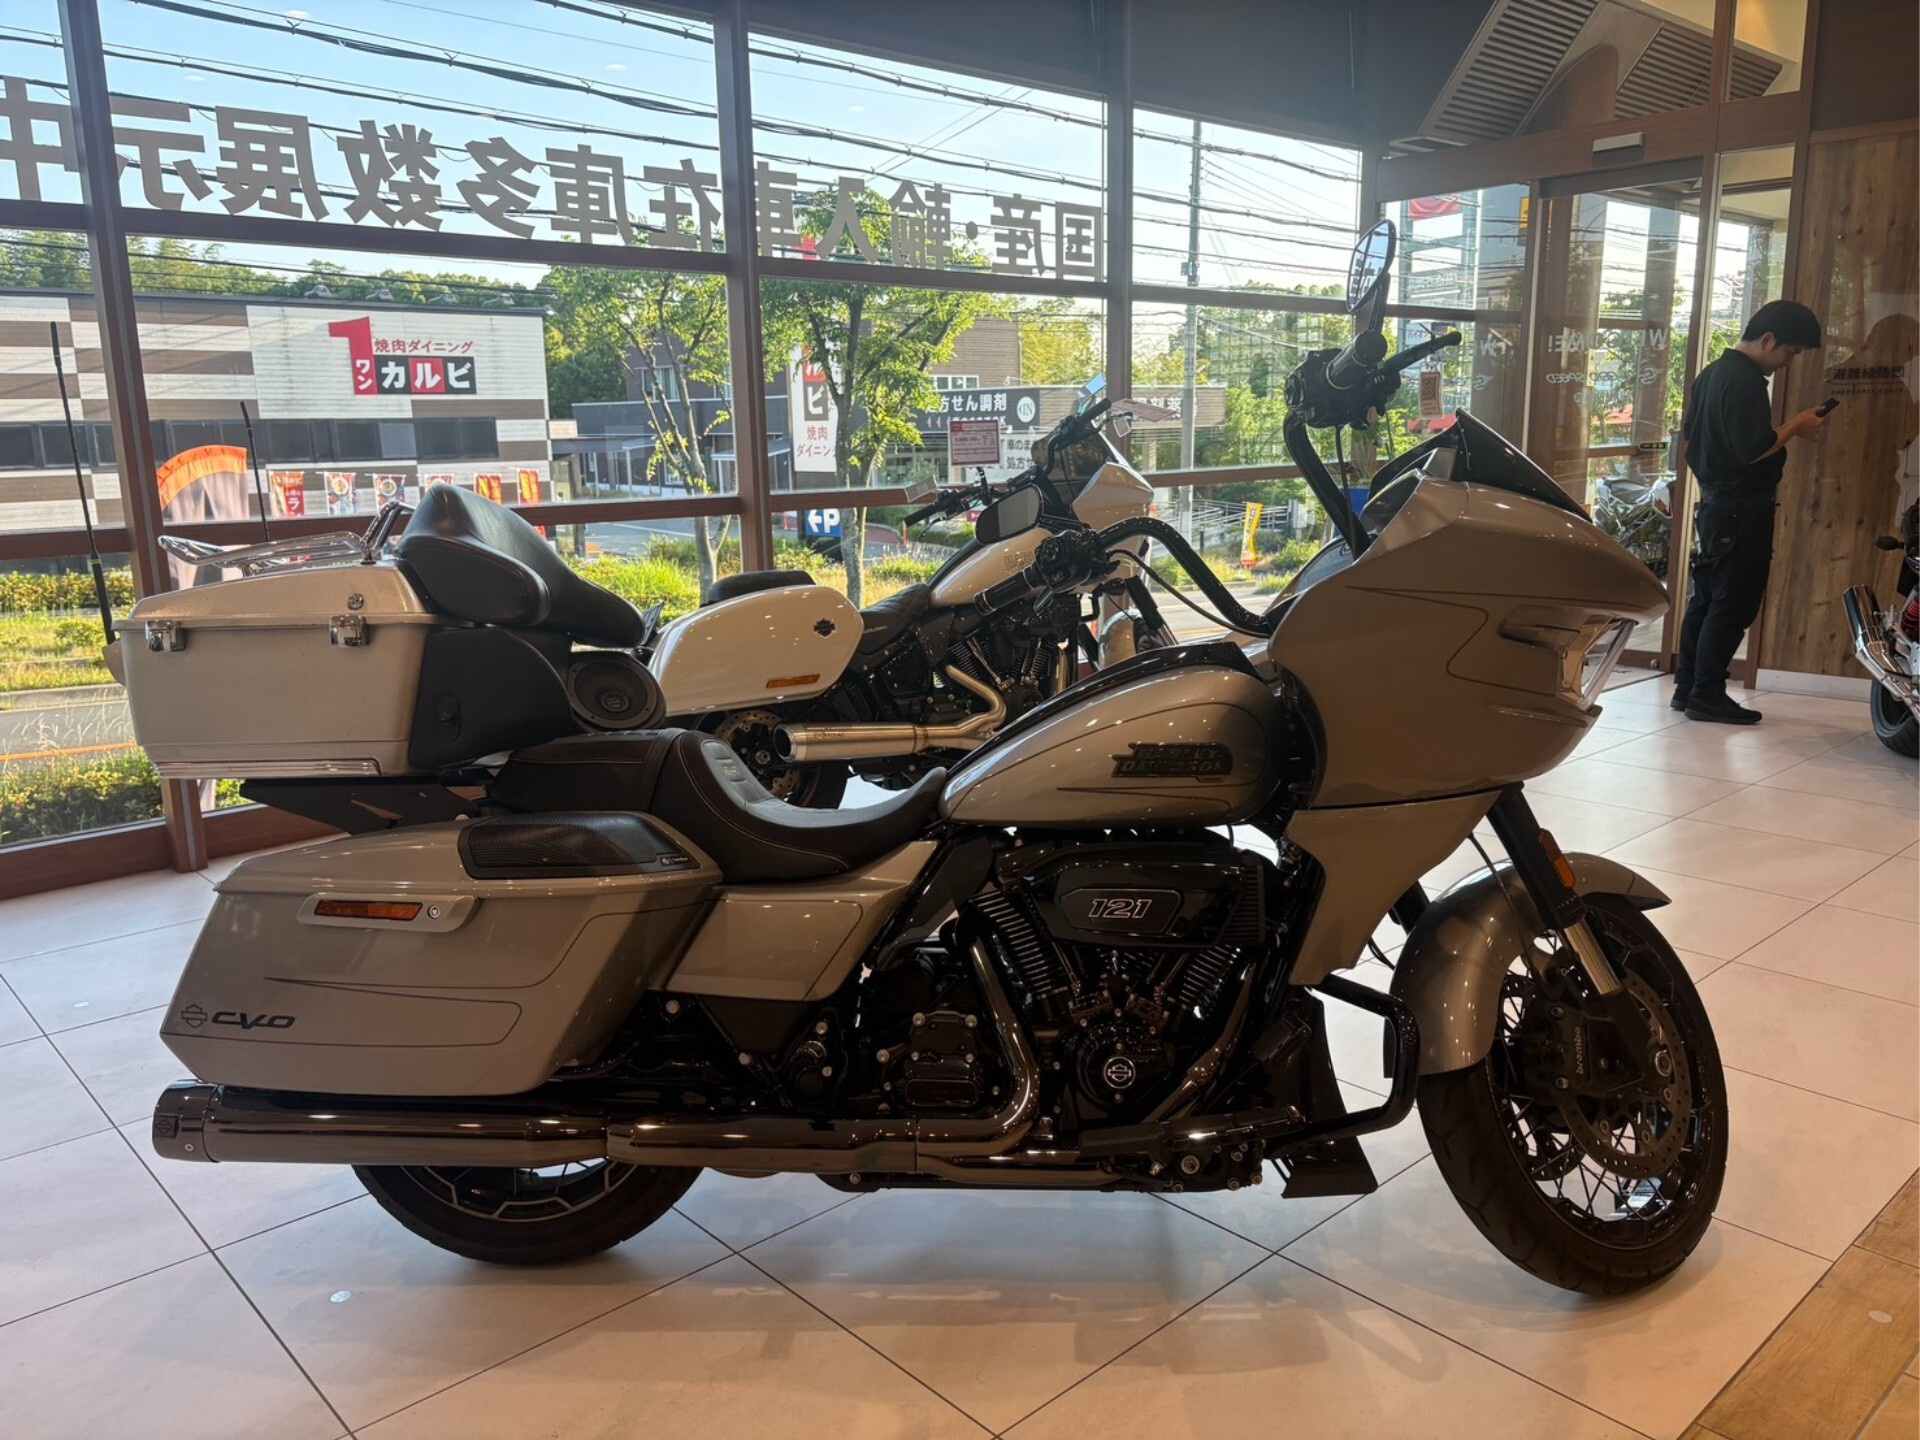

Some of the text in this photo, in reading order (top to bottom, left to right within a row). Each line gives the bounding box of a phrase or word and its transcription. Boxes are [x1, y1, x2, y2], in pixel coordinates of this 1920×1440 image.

[374, 338, 474, 354] 焼肉ダイニング
[355, 359, 373, 391] ワン
[381, 361, 472, 389] カルビ
[807, 426, 828, 441] 焼肉
[823, 508, 841, 533] P
[1088, 898, 1152, 919] 121
[211, 1011, 296, 1029] CVO
[1573, 1026, 1585, 1075] brembo
